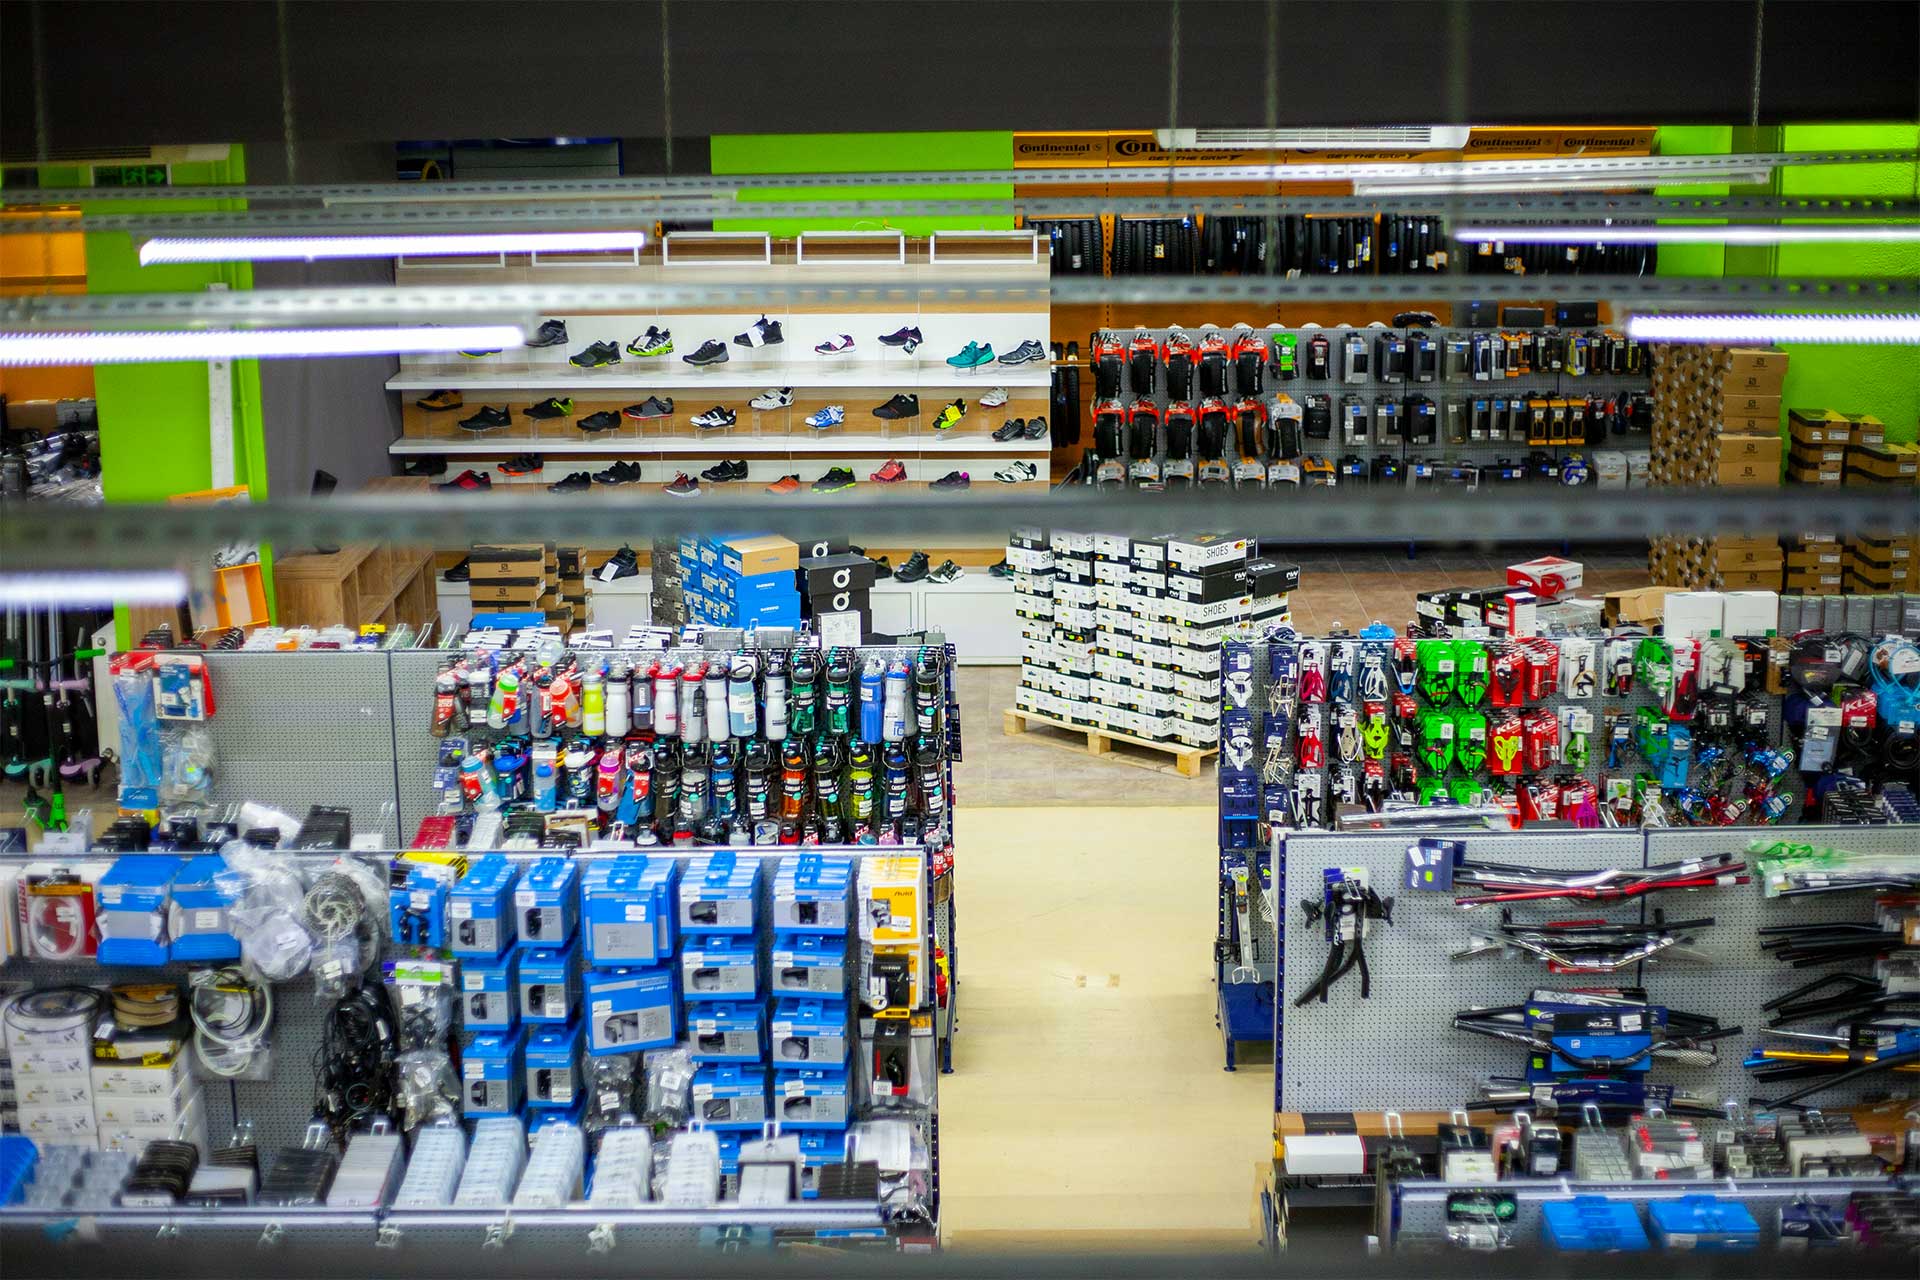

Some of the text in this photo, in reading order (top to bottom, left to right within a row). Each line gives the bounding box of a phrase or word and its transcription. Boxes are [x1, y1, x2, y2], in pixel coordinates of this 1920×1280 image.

[1019, 143, 1090, 153] Continental
[1470, 138, 1541, 148] Continental
[1563, 137, 1635, 147] Continental
[1206, 545, 1229, 559] SHOES
[1203, 603, 1227, 617] SHOES
[1846, 691, 1877, 713] KLS
[1496, 718, 1521, 735] KLS
[1533, 719, 1557, 735] KLS
[1534, 788, 1558, 804] KLS
